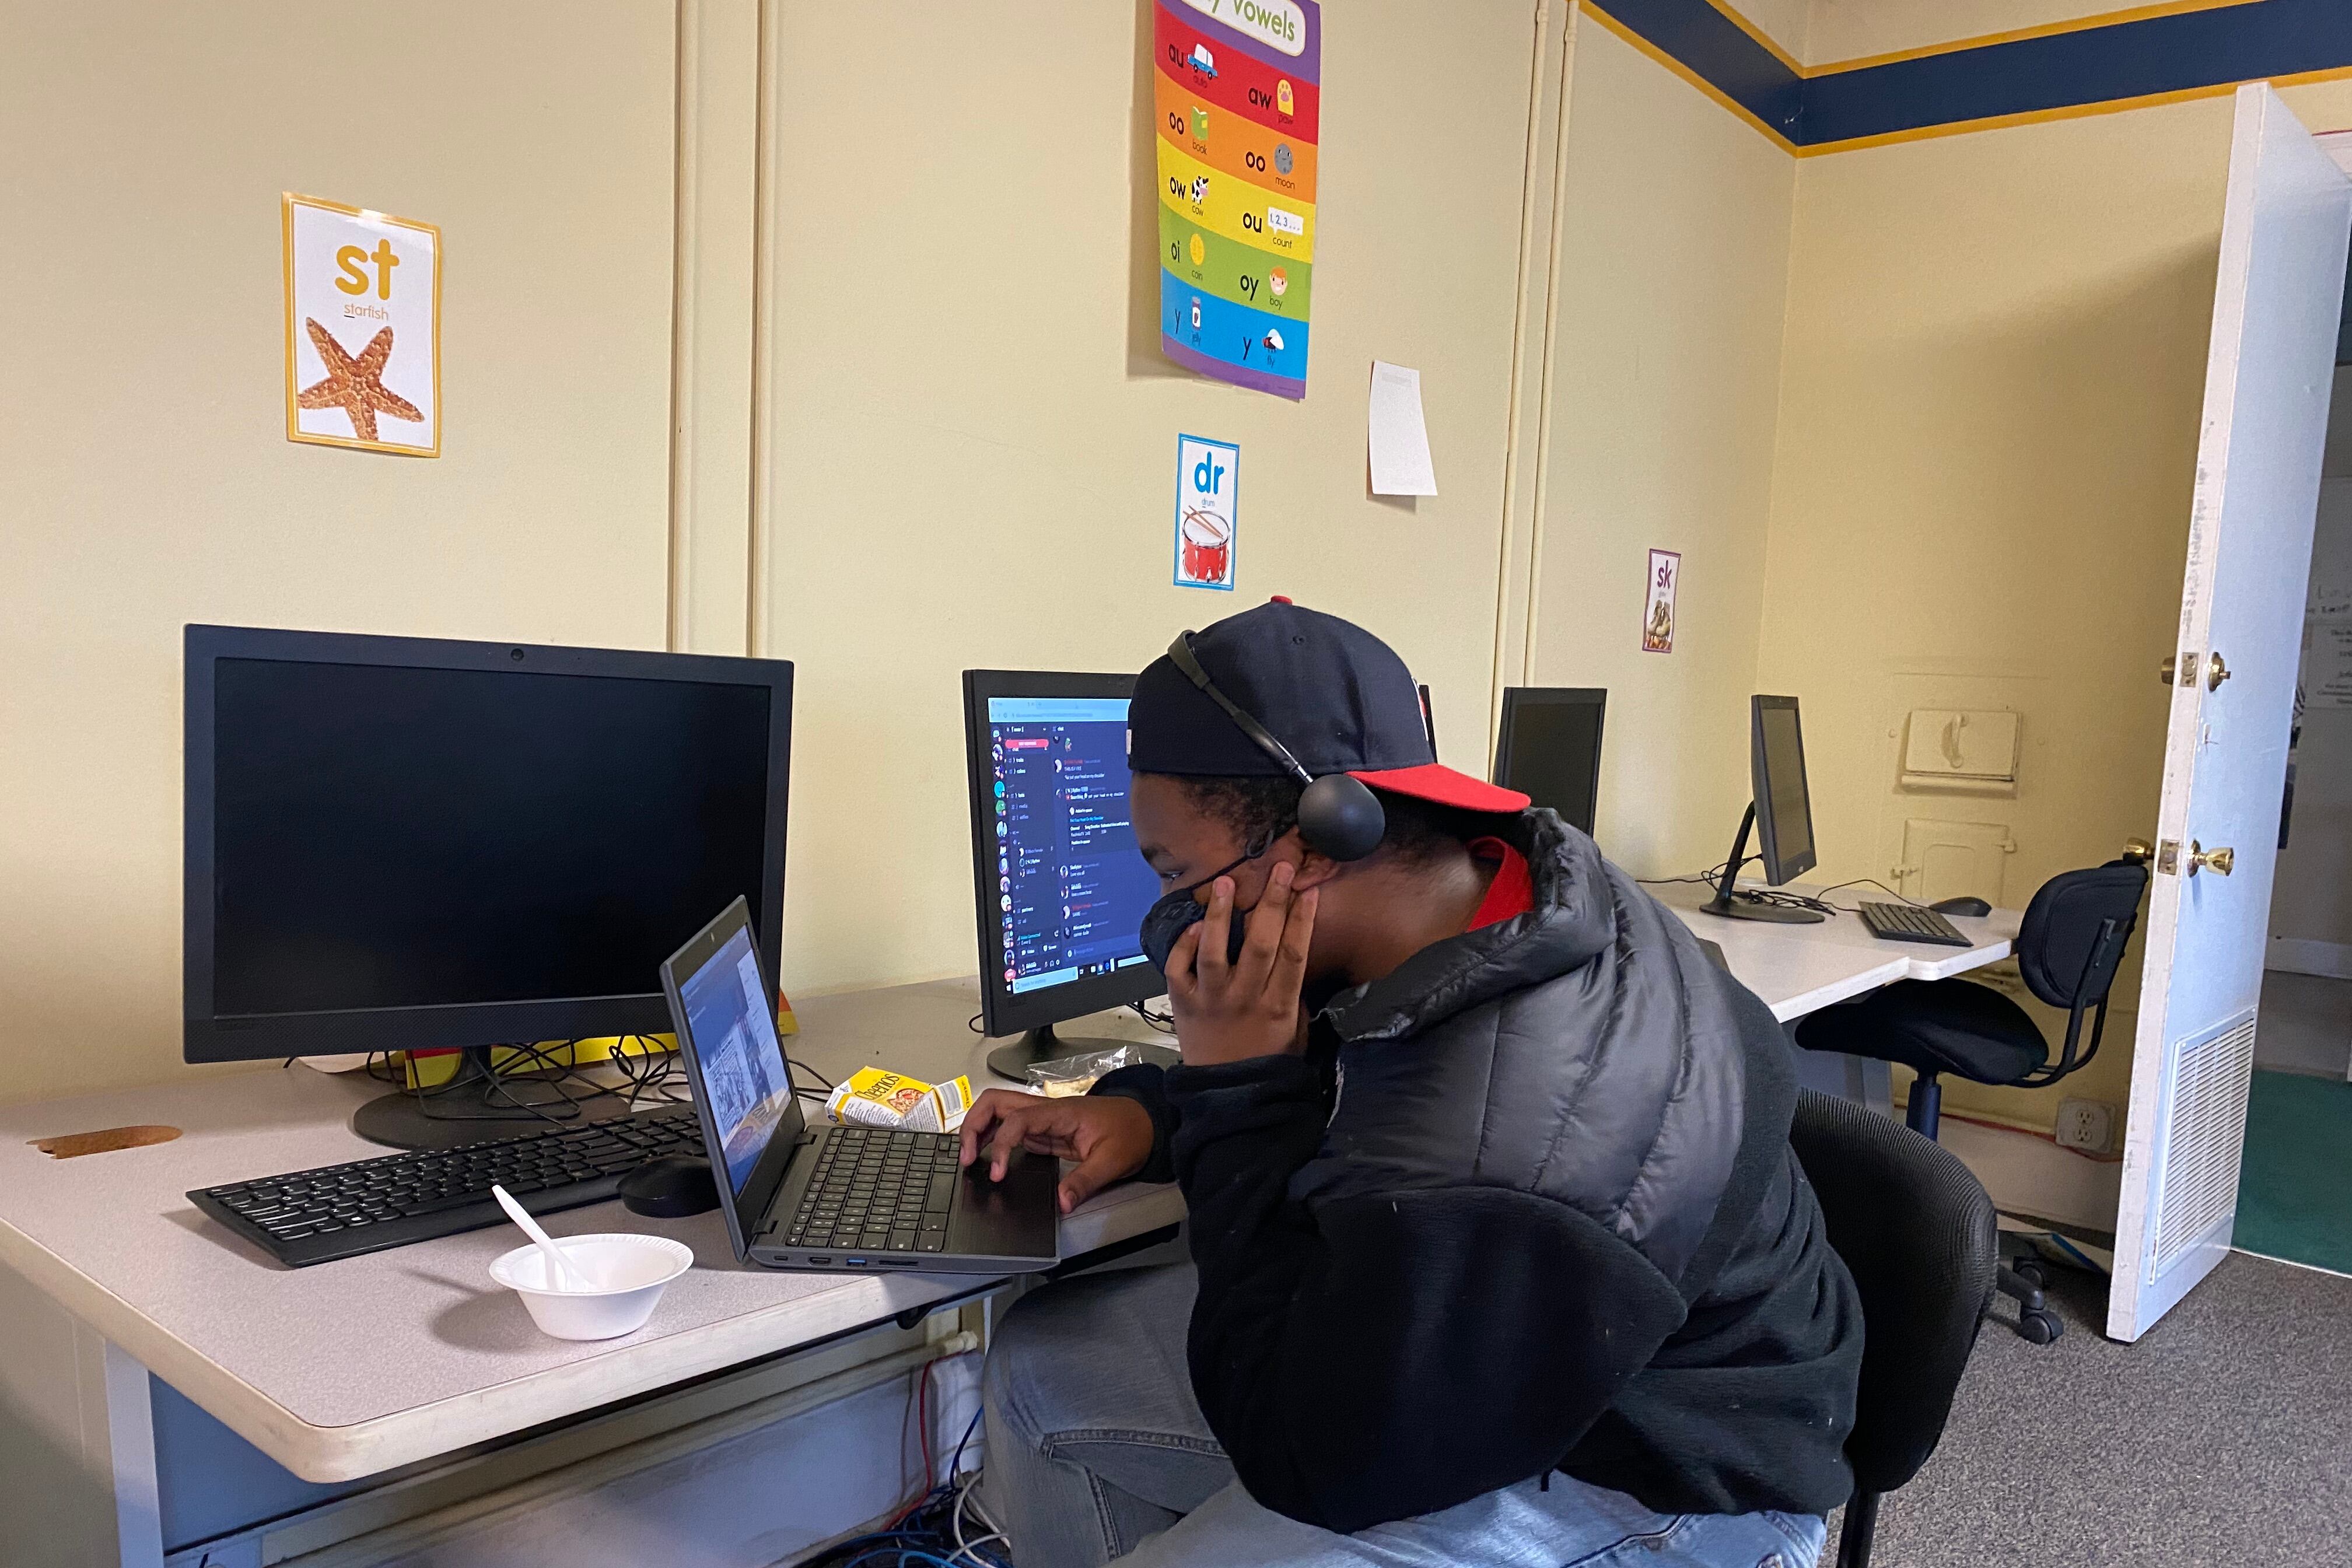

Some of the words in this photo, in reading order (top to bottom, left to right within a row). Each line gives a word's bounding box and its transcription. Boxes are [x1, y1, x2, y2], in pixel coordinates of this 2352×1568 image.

[1168, 44, 1184, 68] au
[1248, 88, 1272, 110] aw
[1170, 112, 1184, 135] oo
[1278, 116, 1293, 125] paw
[1192, 139, 1208, 155] book
[1245, 151, 1265, 172] oo
[1170, 177, 1186, 200] ow
[1275, 177, 1295, 190] moon
[1192, 205, 1203, 216] cow
[1242, 212, 1262, 233] ou
[1171, 240, 1180, 263] oi
[1272, 236, 1292, 249] count
[335, 238, 400, 300] st
[1191, 269, 1203, 281] coin
[1240, 275, 1259, 301] oy
[344, 303, 388, 320] starfish
[1269, 296, 1283, 310] boy
[1175, 309, 1181, 334] y
[1242, 337, 1252, 360] y
[1194, 452, 1224, 495] dr
[1202, 498, 1215, 507] drum
[1657, 559, 1672, 590] sk
